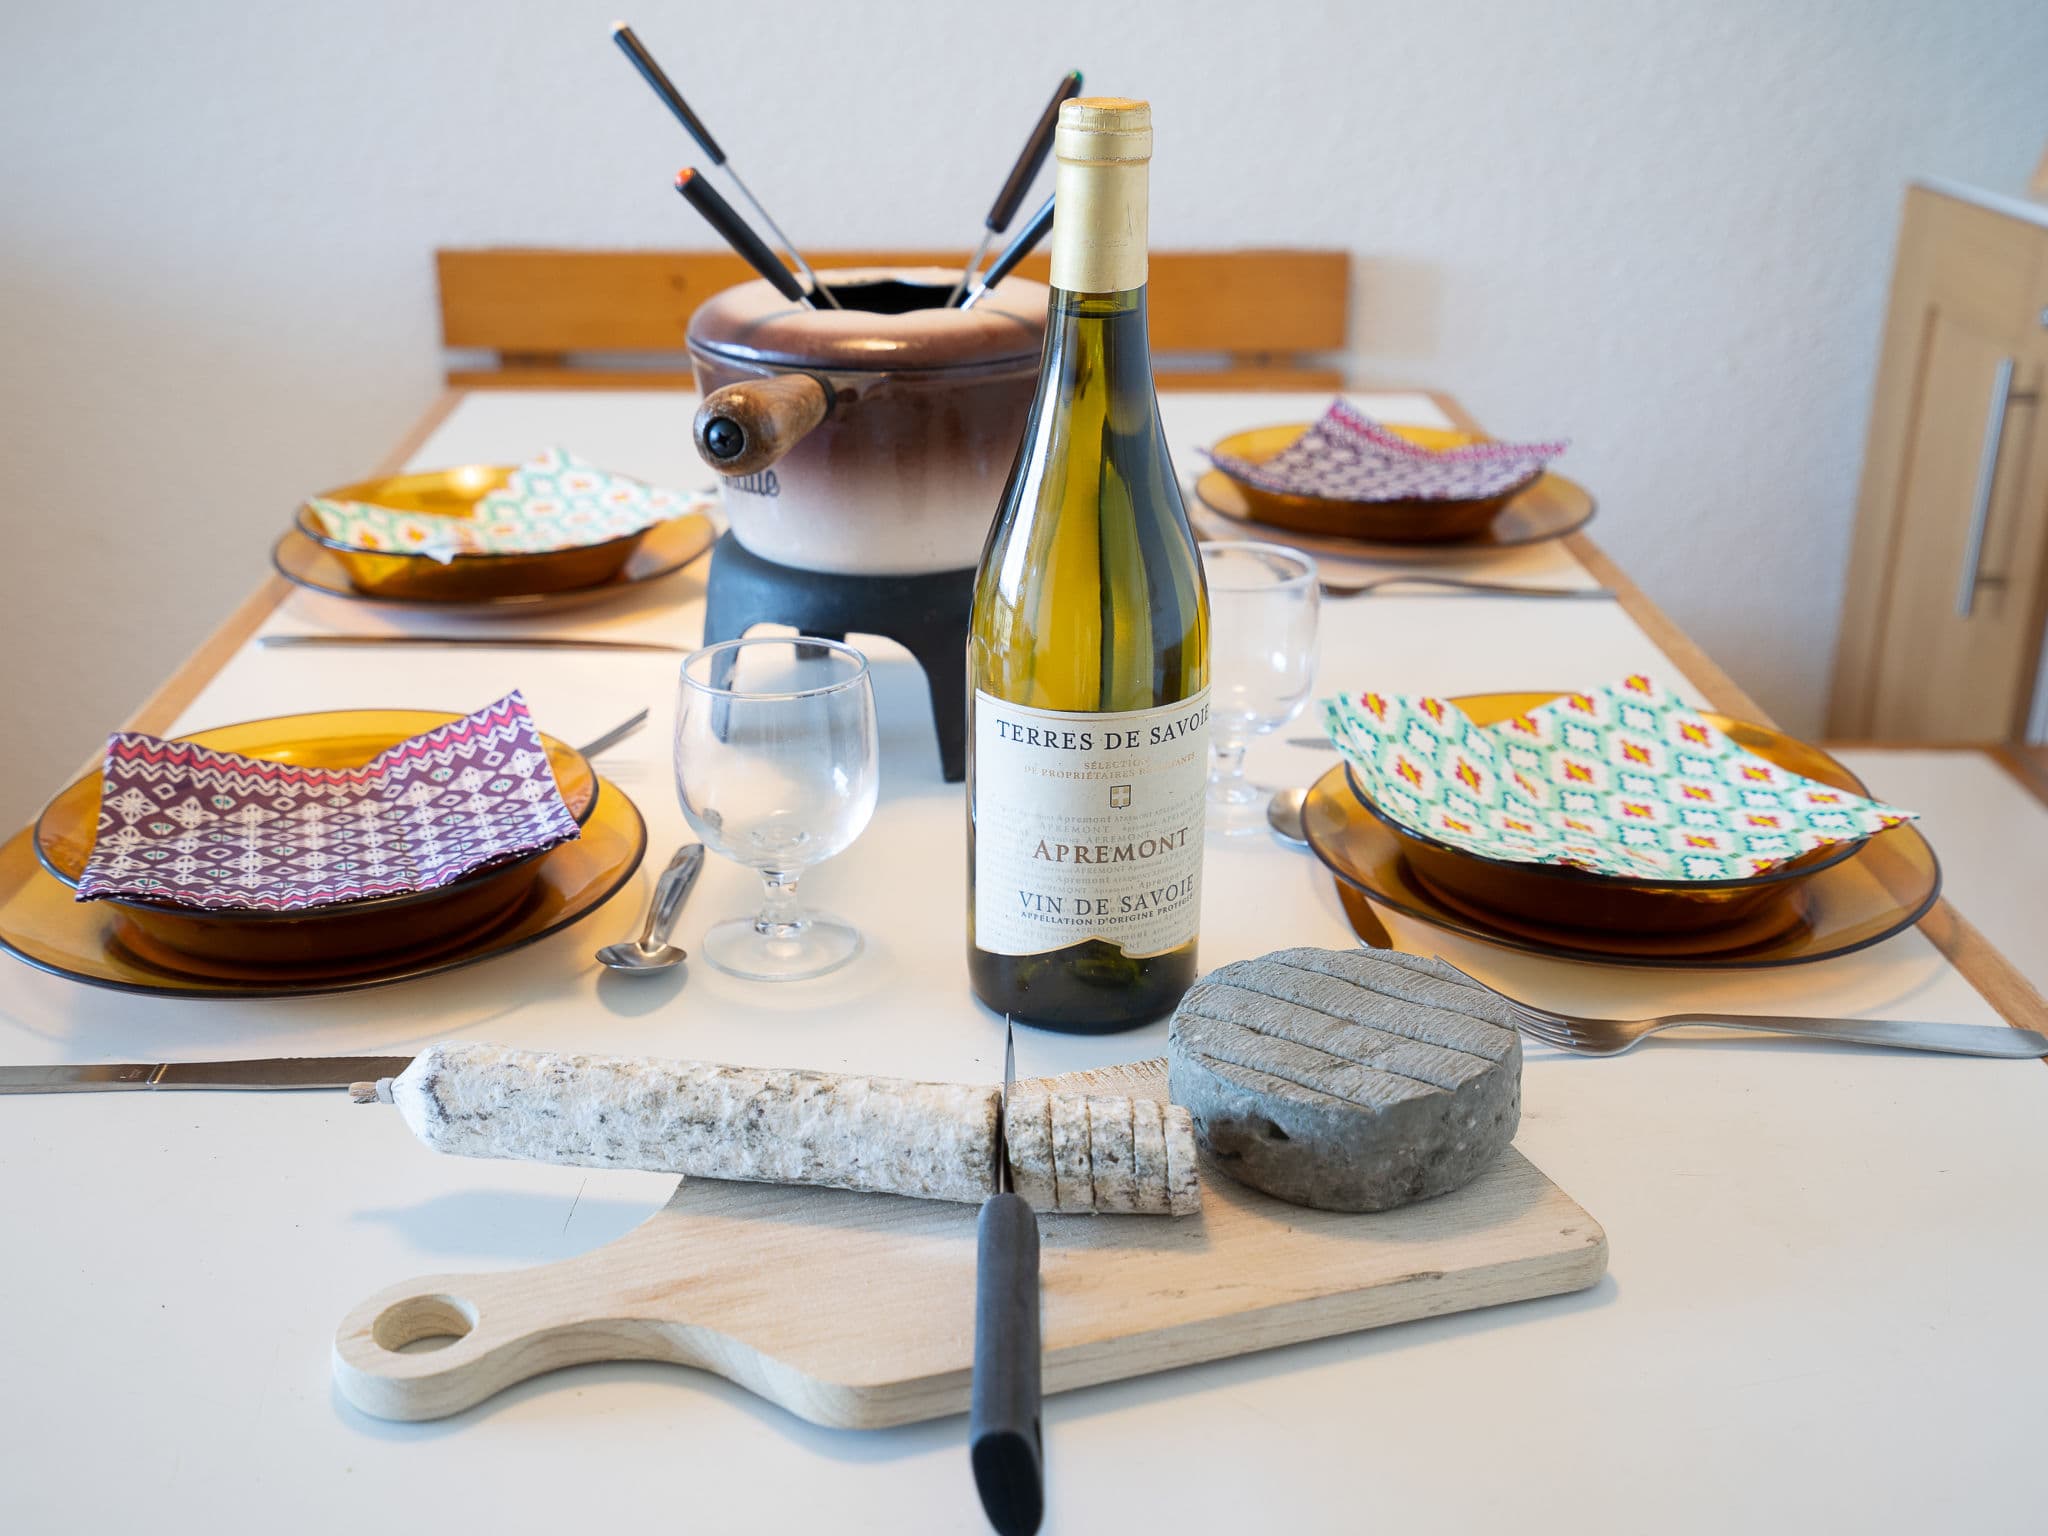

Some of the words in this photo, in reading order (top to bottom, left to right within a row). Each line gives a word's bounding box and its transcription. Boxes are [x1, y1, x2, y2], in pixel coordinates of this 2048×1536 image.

[997, 719, 1093, 751] TERRES
[1104, 730, 1141, 751] DE
[1149, 703, 1209, 746] SAVOIE
[1024, 764, 1039, 776] DE
[1041, 766, 1135, 780] PROPRIÉTAIRES
[1033, 826, 1189, 864] APREMONT
[1018, 890, 1062, 914] VIN
[1076, 898, 1110, 916] DE
[1120, 873, 1194, 914] SAVOIE
[1020, 911, 1093, 926] APPELLATION
[1097, 910, 1154, 926] D'ORIGINE
